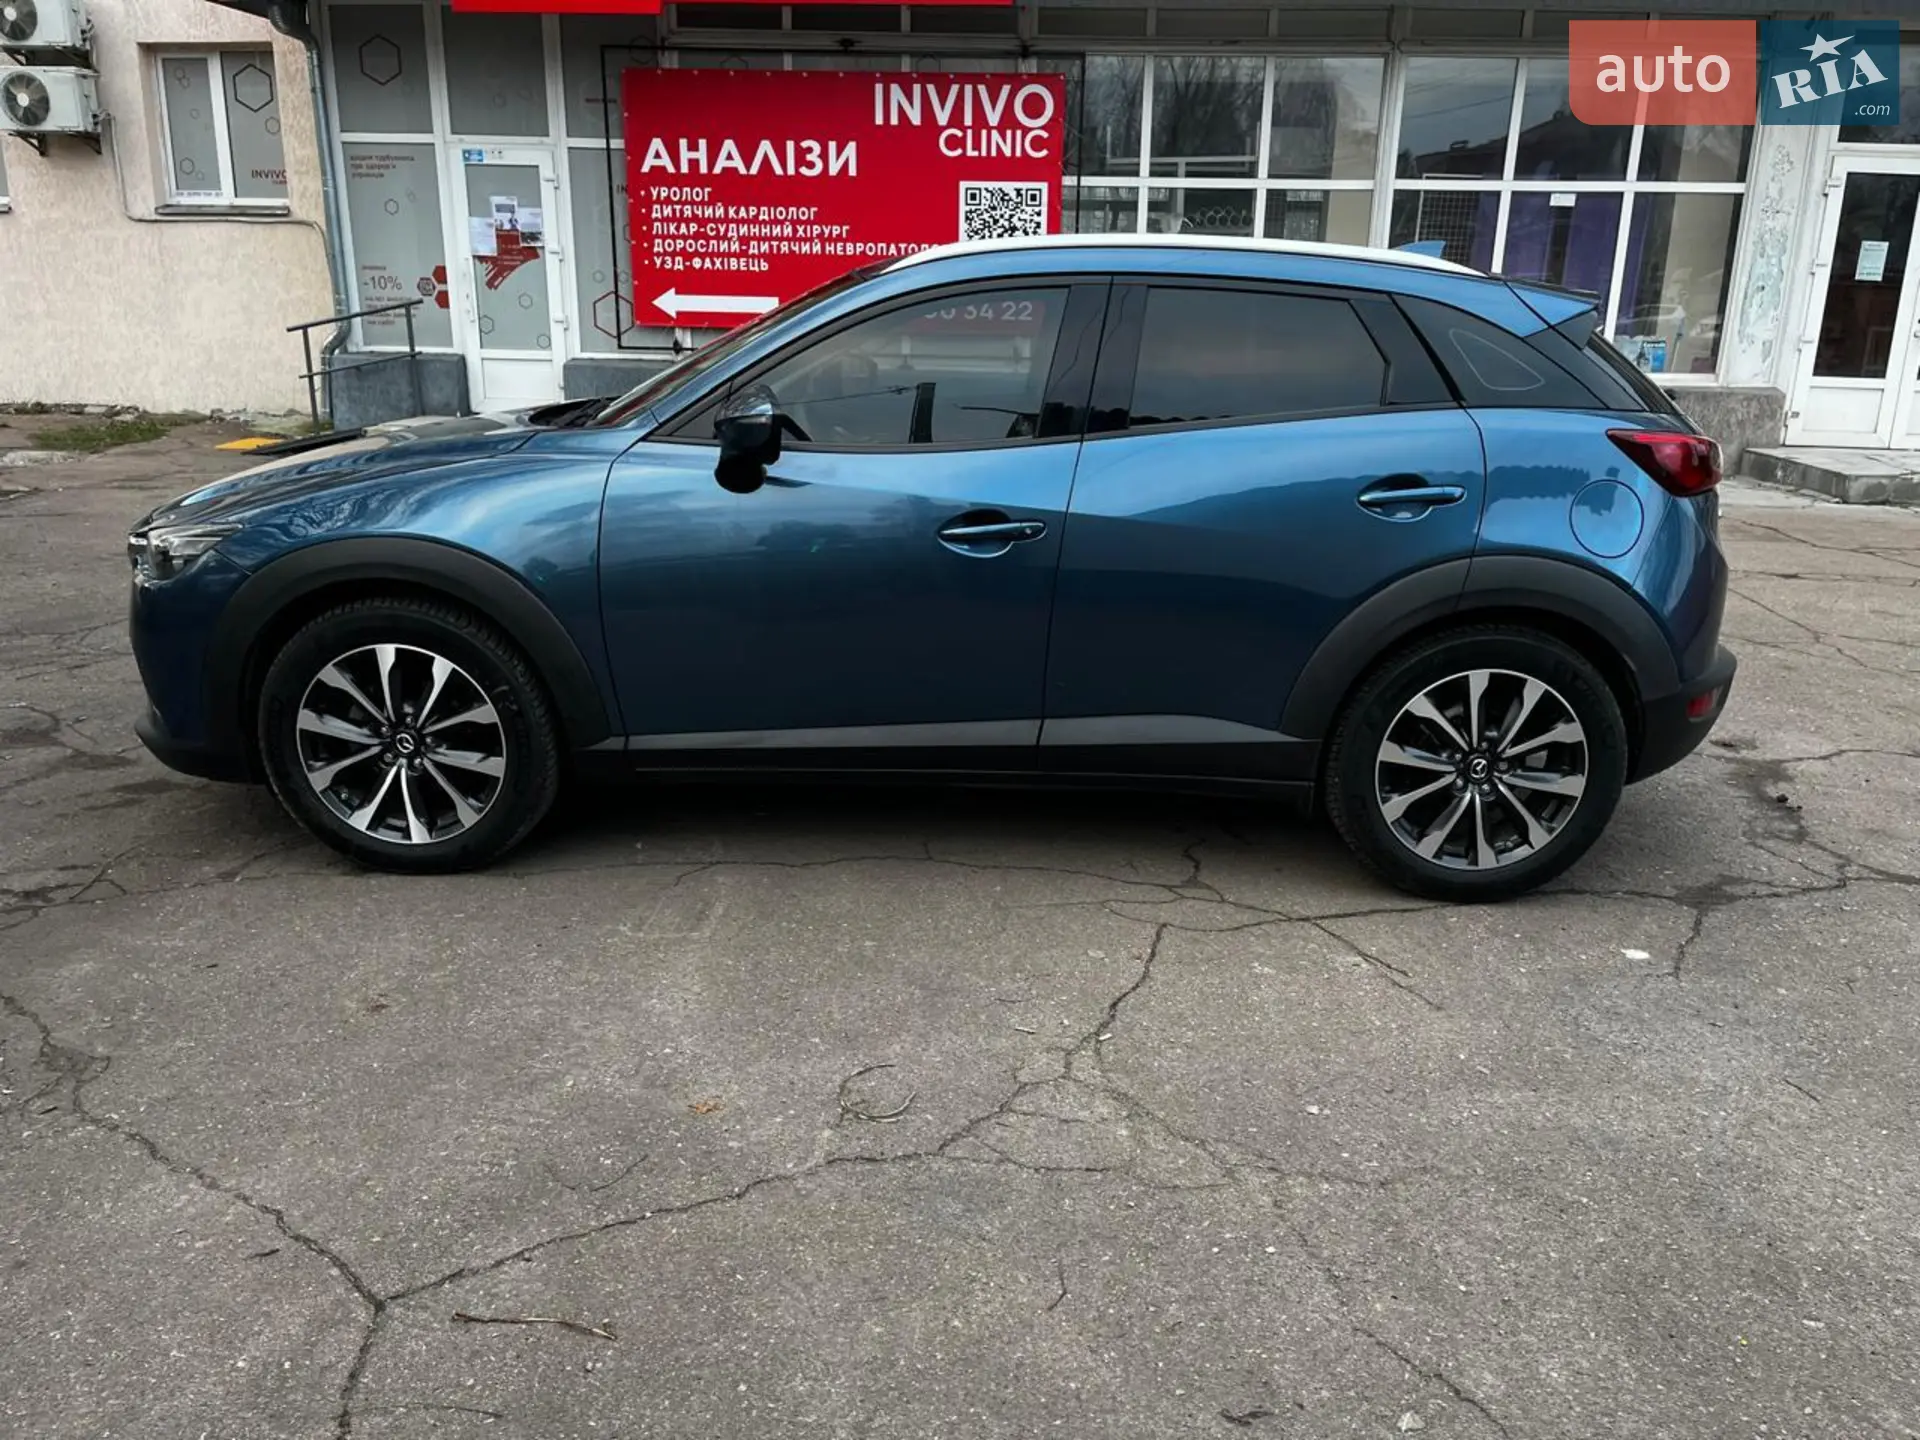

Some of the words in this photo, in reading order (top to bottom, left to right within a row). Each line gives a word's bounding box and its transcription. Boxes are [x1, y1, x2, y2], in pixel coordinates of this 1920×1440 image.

[876, 83, 1054, 128] INVIVO
[938, 127, 1049, 158] CLINIC
[640, 137, 858, 177] АНАЛІЗИ
[650, 186, 712, 202] УРОЛОГ
[651, 203, 724, 219] ДИТЯЧИЙ
[729, 206, 818, 221] КАРДІОЛОГ
[652, 222, 793, 237] ЛІКАР-СУДИННИЙ
[796, 225, 850, 238] ХІРУРГ
[653, 237, 822, 255] ДОРОСЛИЙ-ДИТЯЧИЙ
[653, 255, 769, 272] УЗД-ФАХІВЕЦЬ
[363, 275, 403, 290] -10%
[1001, 301, 1033, 320] 22
